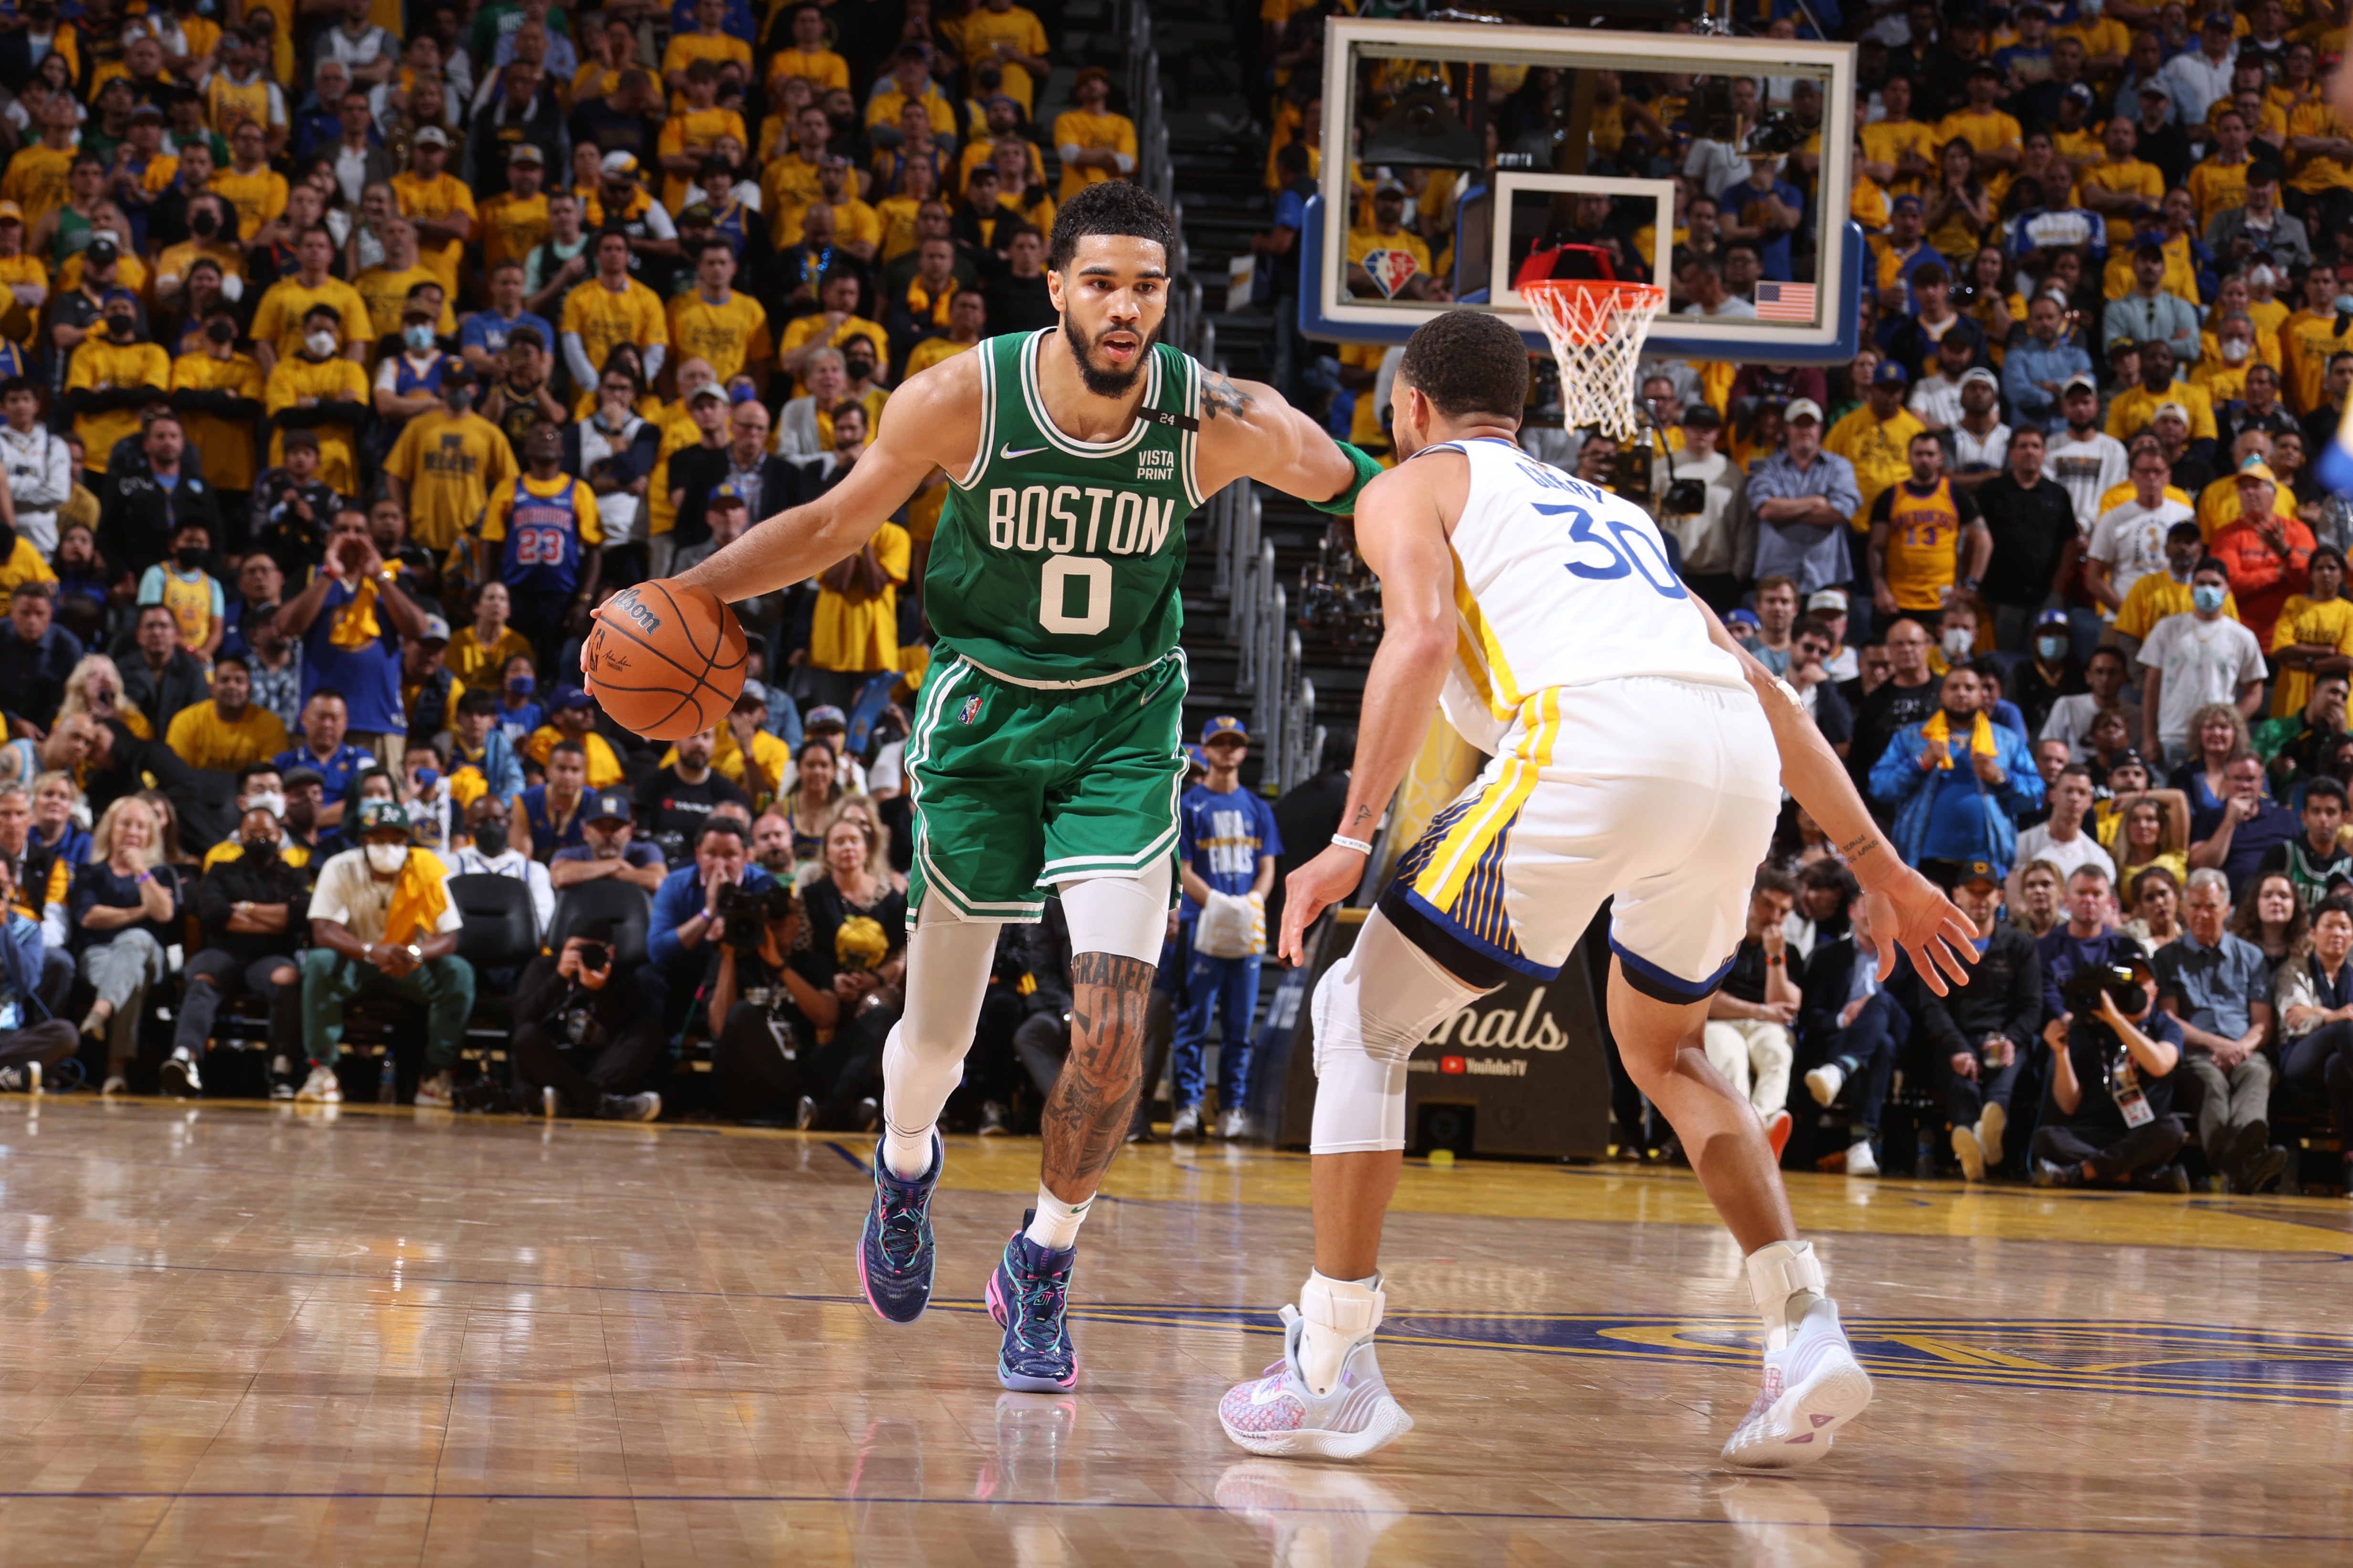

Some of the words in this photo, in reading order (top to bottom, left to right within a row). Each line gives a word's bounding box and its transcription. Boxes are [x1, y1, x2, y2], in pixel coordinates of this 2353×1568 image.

[1160, 412, 1175, 426] 24
[1137, 467, 1174, 481] PRINT
[1139, 449, 1174, 469] VISTA
[1515, 462, 1605, 504] CURRY
[989, 485, 1175, 555] BOSTON
[517, 528, 565, 565] 23
[1531, 502, 1688, 600] 30
[1040, 555, 1112, 635] 0
[1422, 981, 1569, 1051] nals
